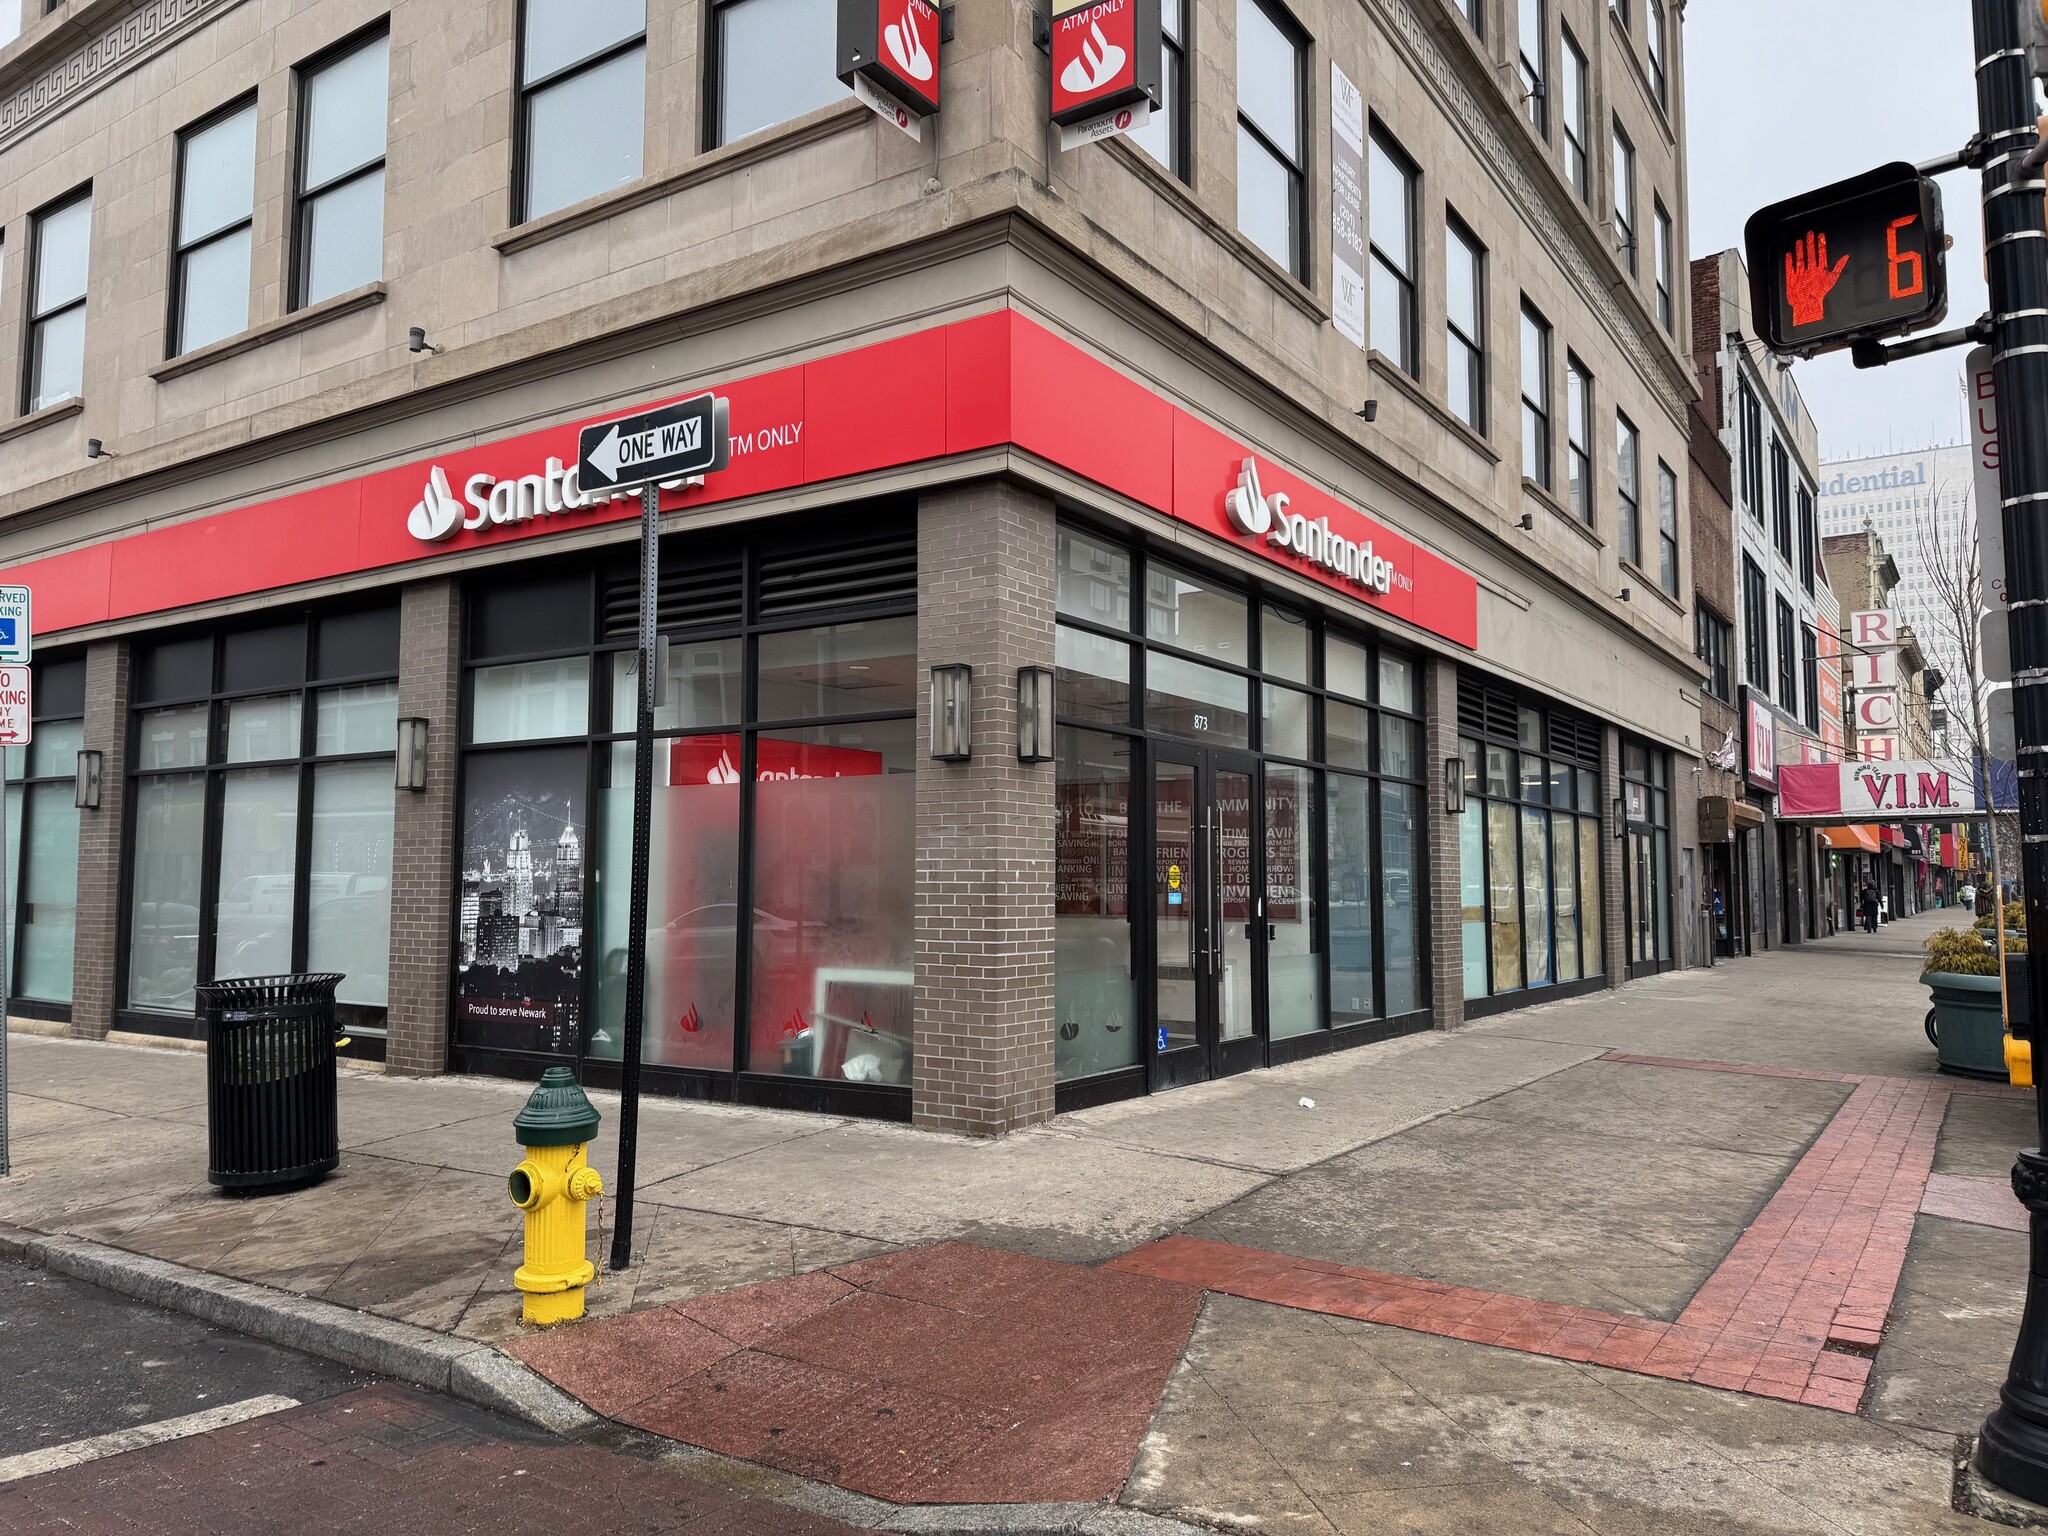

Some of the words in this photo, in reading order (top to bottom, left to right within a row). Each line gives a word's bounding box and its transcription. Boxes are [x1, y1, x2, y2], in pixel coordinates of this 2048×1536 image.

[1061, 10, 1089, 33] ATM
[1092, 0, 1124, 20] ONLY
[1077, 116, 1114, 135] Paramount
[1090, 125, 1114, 138] Assets
[1333, 178, 1345, 197] FOR
[1345, 190, 1360, 213] LEASE
[1340, 202, 1355, 231] (201)
[1887, 213, 1924, 300] 6
[619, 432, 655, 464] ONE
[661, 420, 699, 454] WAY
[729, 433, 753, 458] TM
[757, 421, 803, 451] ONLY
[1266, 492, 1394, 595] Santander
[1397, 573, 1413, 593] ONLY
[0, 593, 26, 603] RVED
[1, 672, 10, 688] O
[1194, 714, 1208, 730] 873
[1854, 764, 1871, 782] WINNING
[1871, 766, 1882, 781] TEAM
[1861, 771, 1960, 810] V.I.M.
[1156, 801, 1182, 813] THE
[1156, 847, 1189, 858] FRIEN
[1959, 838, 1967, 869] NAILS
[1057, 865, 1092, 873] ANKING
[468, 1003, 489, 1015] Proud
[490, 1005, 498, 1015] to
[498, 1007, 518, 1017] serve
[519, 1007, 547, 1019] Newark
